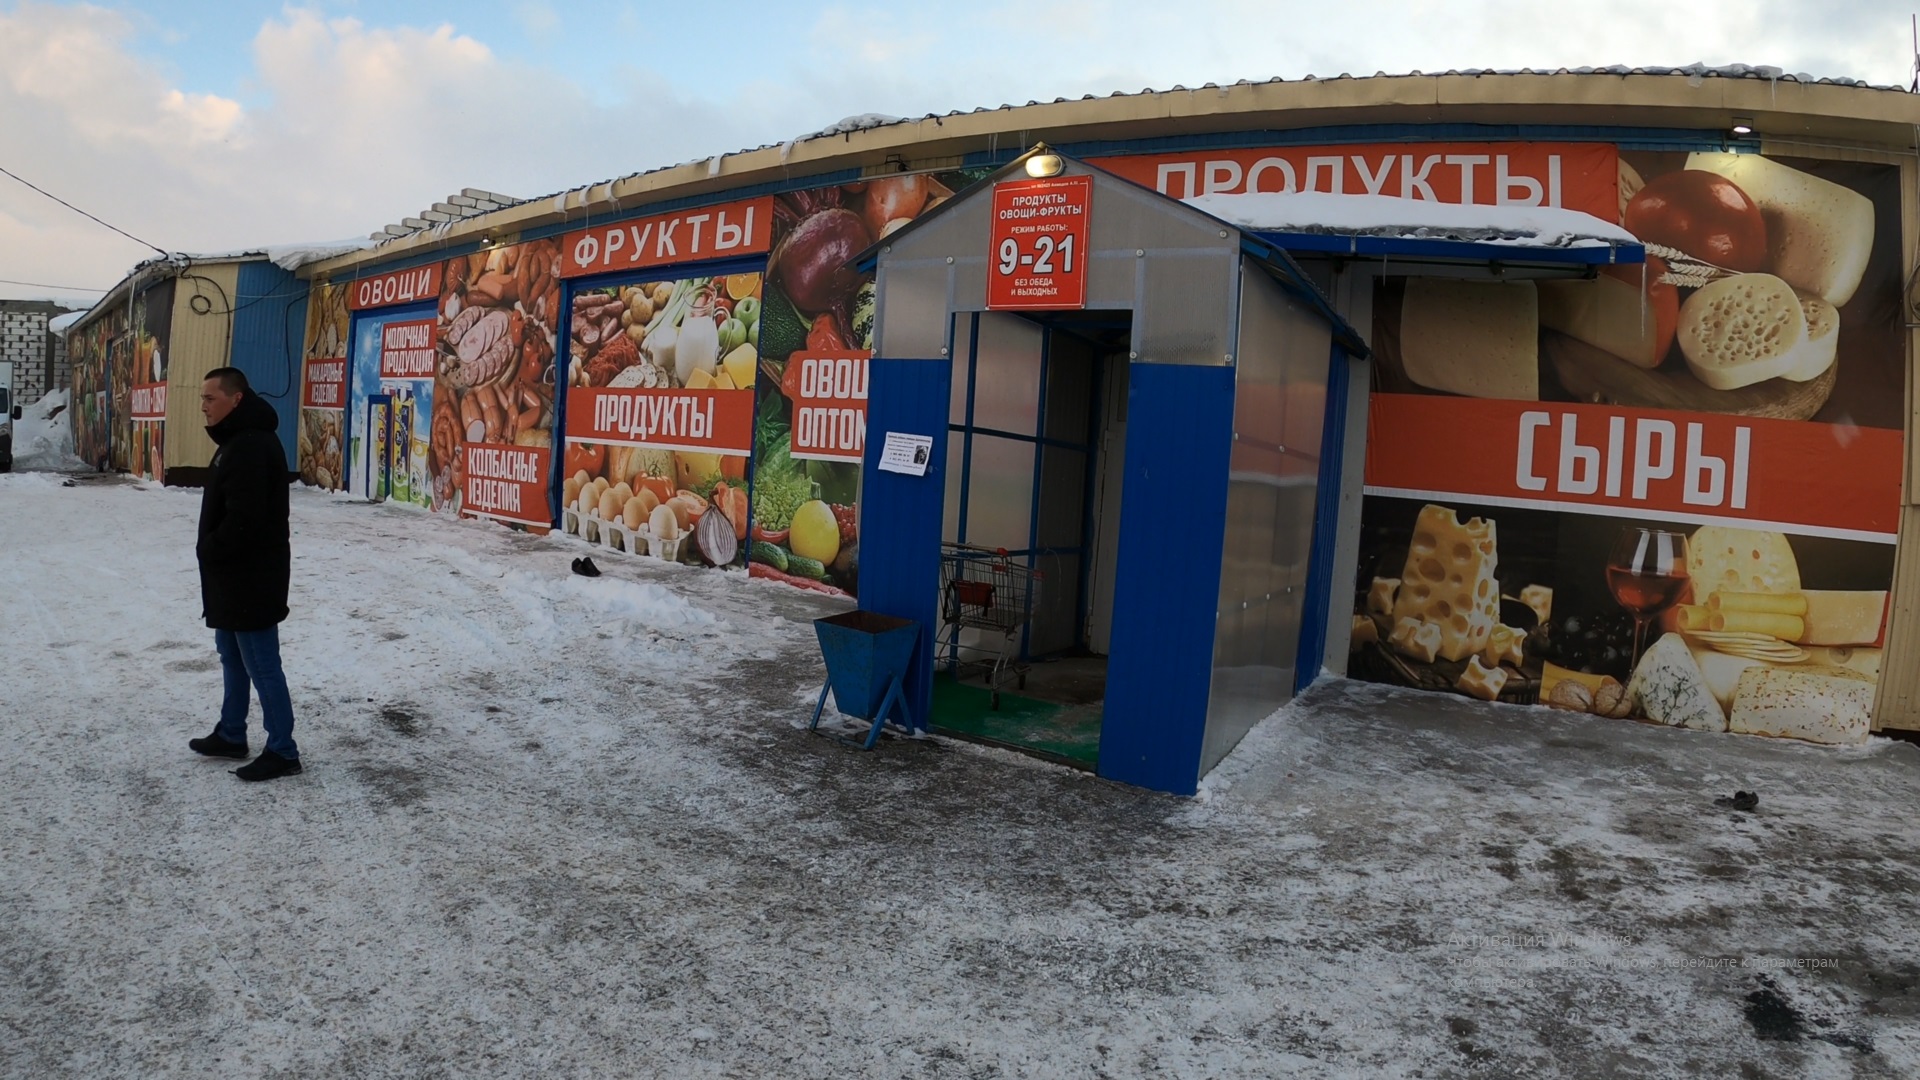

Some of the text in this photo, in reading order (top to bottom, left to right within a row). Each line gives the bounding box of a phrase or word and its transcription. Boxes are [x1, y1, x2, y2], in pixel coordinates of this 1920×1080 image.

[1000, 205, 1082, 219] ОВОЩИ-ФРУКТЫ
[1012, 193, 1067, 207] ПРОДУКТЫ
[574, 206, 754, 268] ФРУКТЫ
[1011, 224, 1068, 234] РЕЖИМ РАБОТЫ:
[999, 234, 1075, 275] 9-21
[360, 268, 431, 306] ОВОЩИ
[1011, 287, 1058, 297] И ВЫХОДНЫХ
[1015, 278, 1053, 287] БЕЗ ОБЕДА
[385, 324, 430, 350] МОЛОЧНАЯ
[383, 349, 434, 376] ПРОДУКЦИЯ
[311, 383, 338, 405] ИЗДЕЛИЯ
[594, 394, 714, 440] ПРОДУКТЫ
[468, 447, 538, 484] КОЛБАСНЫЕ
[1516, 411, 1751, 509] СЫРЫ
[468, 477, 521, 513] ИЗДЕЛИЯ
